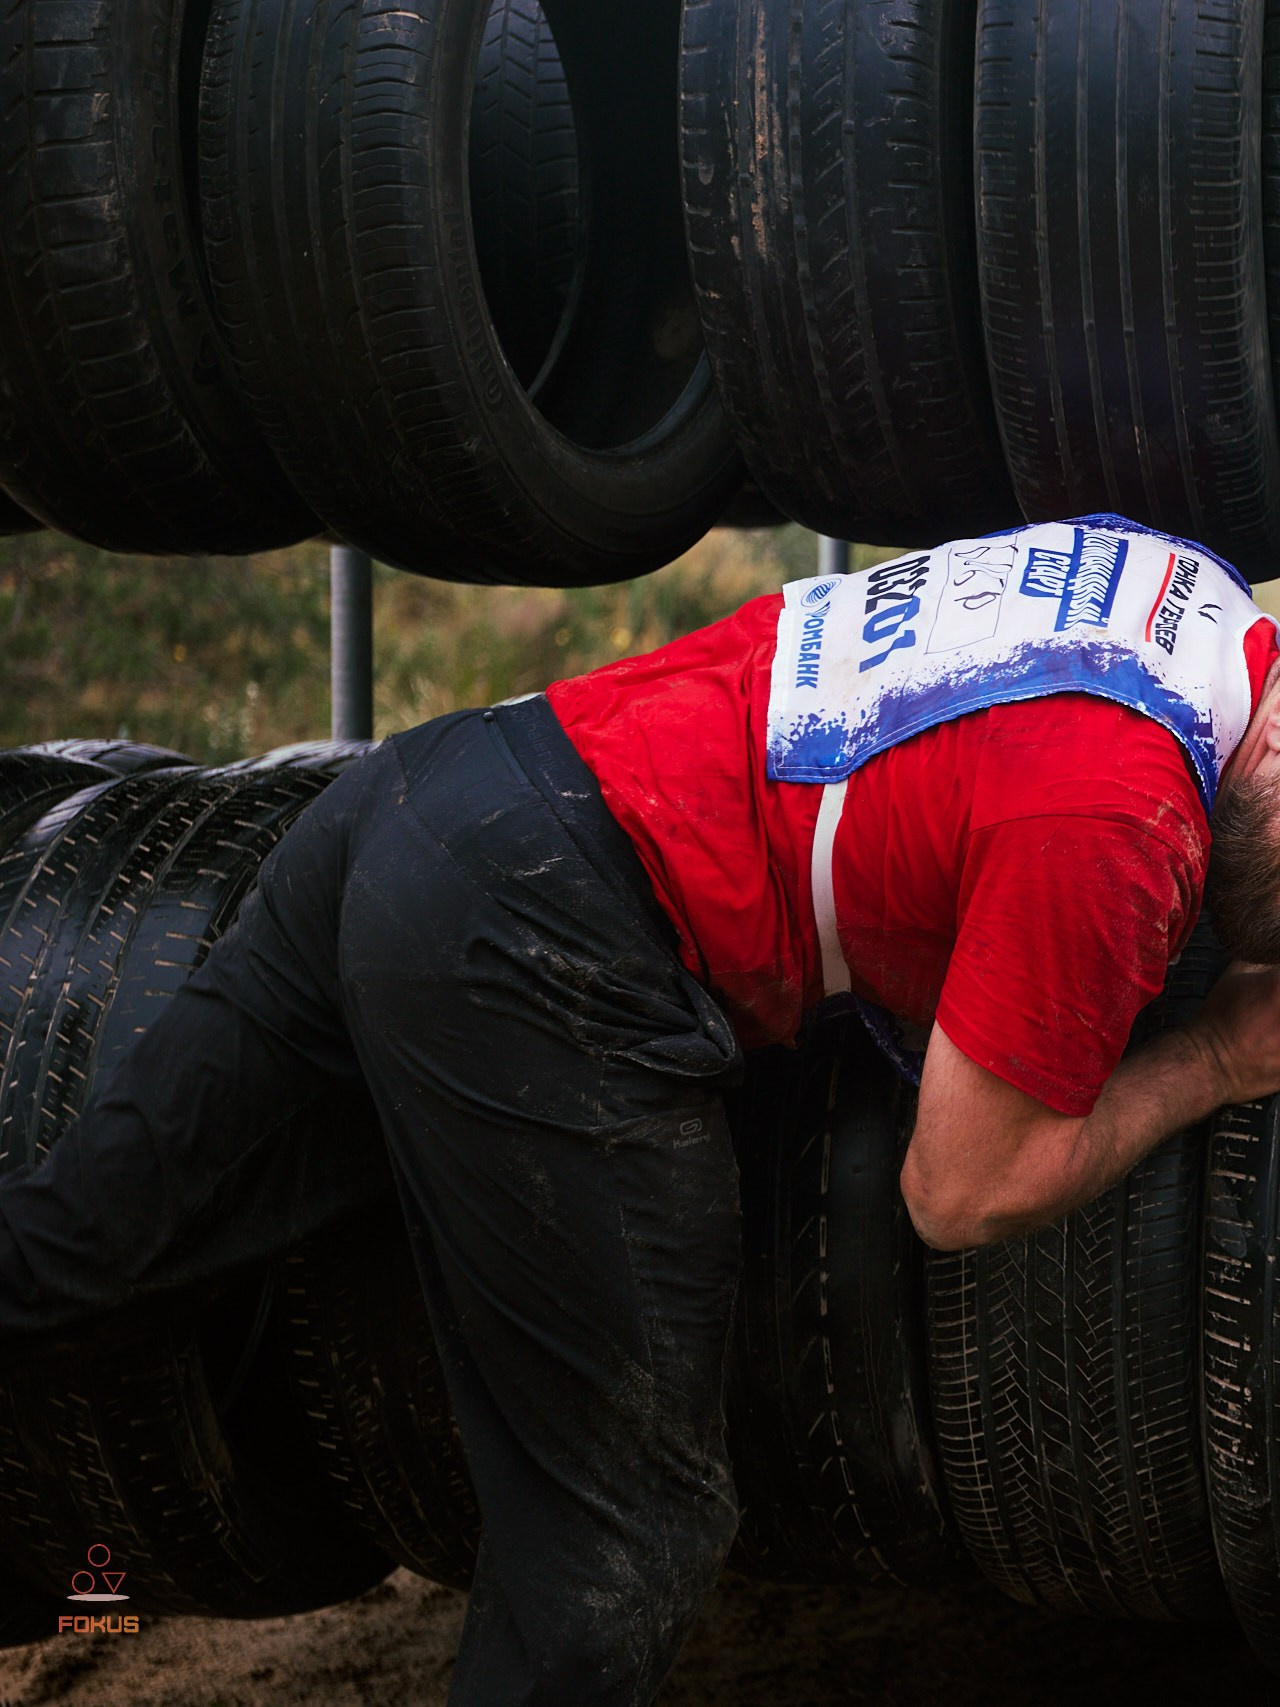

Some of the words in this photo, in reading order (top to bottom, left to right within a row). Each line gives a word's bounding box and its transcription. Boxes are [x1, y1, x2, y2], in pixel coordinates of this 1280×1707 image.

[1025, 551, 1071, 597] СТАРТ
[1064, 530, 1120, 629] КОМАНДНЫЙ
[1169, 555, 1200, 601] ГОНКА
[859, 555, 931, 673] 03201
[1155, 598, 1186, 656] ГЕРОЕВ
